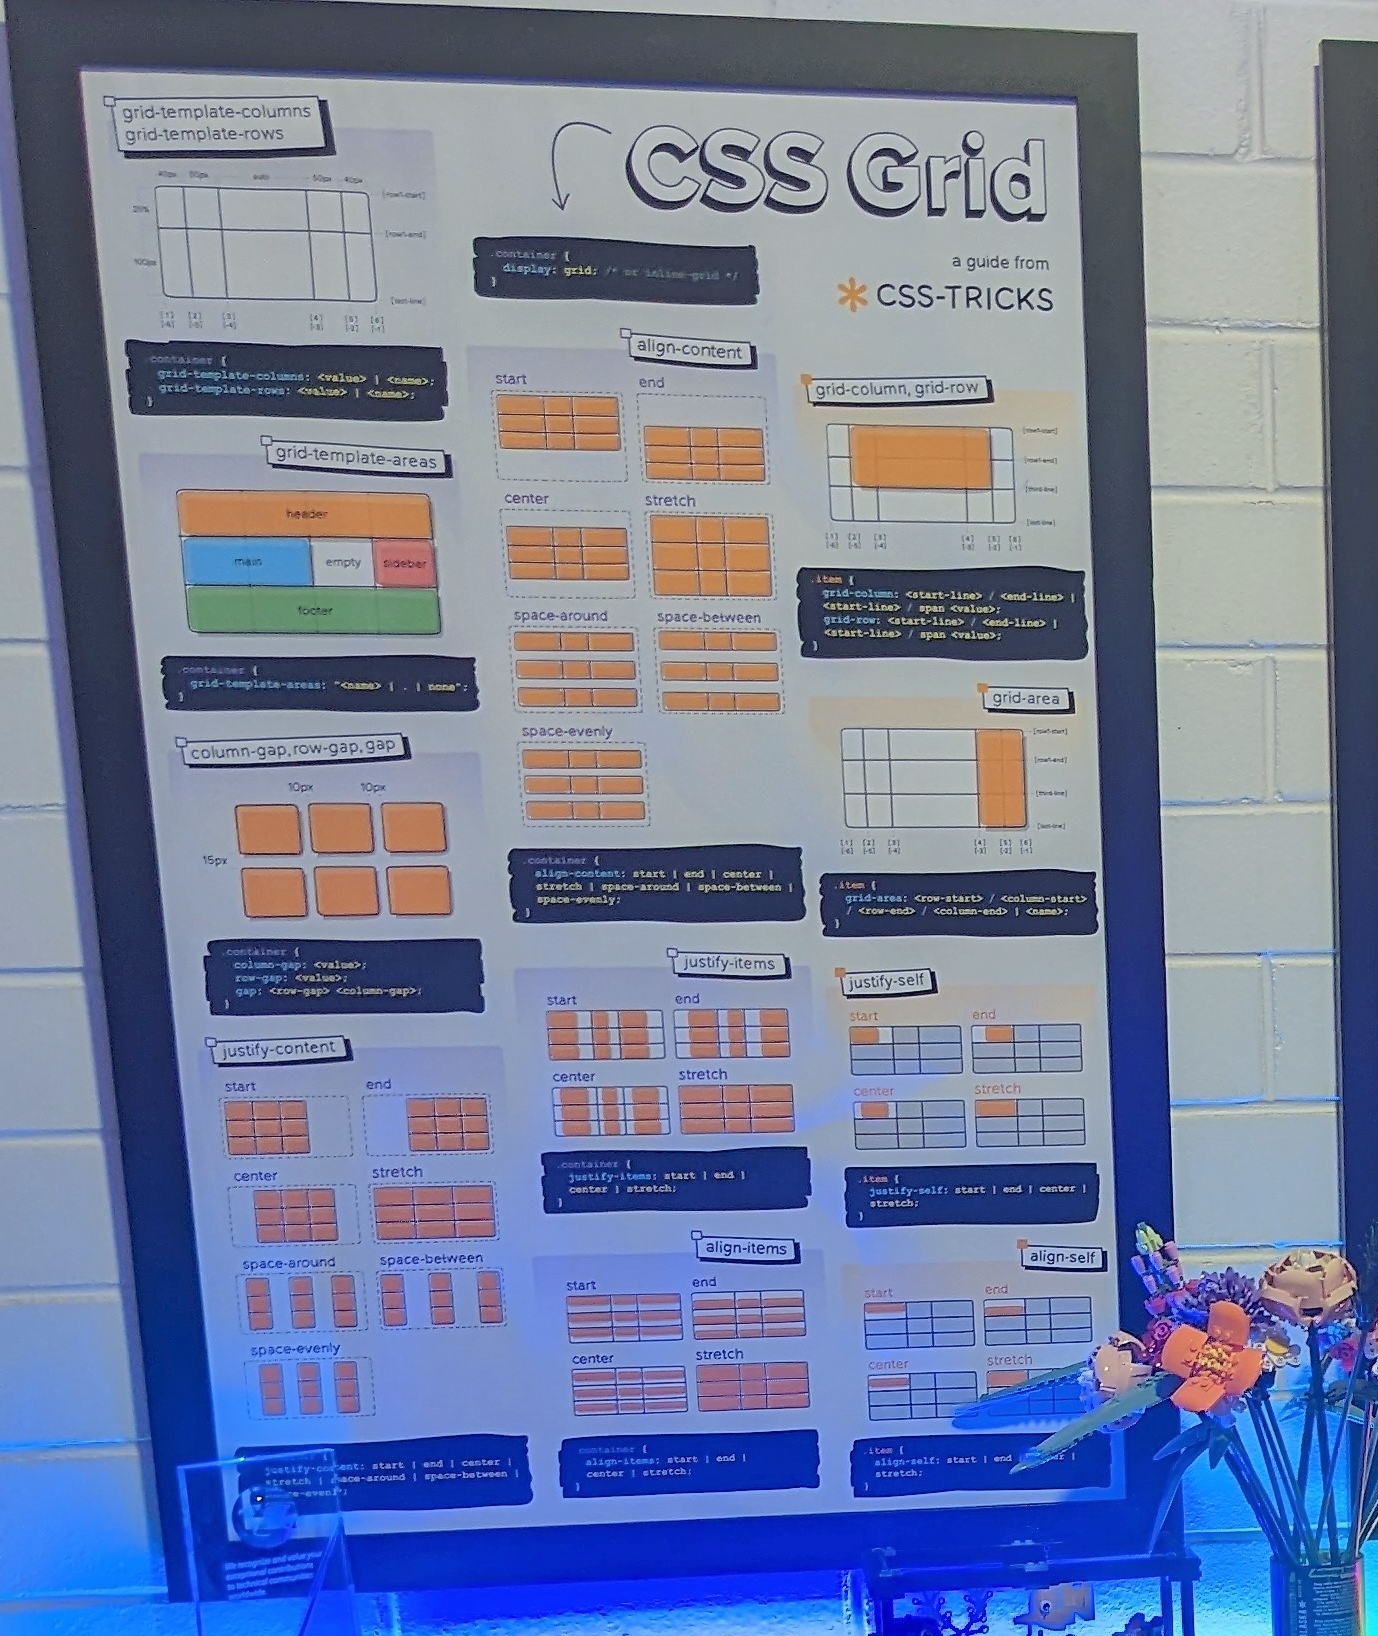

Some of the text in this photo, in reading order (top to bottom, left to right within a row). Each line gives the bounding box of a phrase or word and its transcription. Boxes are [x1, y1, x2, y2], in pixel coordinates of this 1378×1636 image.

[122, 103, 311, 121] grid-template-columns
[125, 124, 284, 143] grid-template-rows
[625, 124, 1049, 222] CSS Grid
[502, 261, 557, 276] display:
[563, 263, 597, 276] grid;
[952, 254, 1050, 275] a guide from
[876, 284, 1054, 312] CSS-TRICKS
[637, 338, 743, 361] align-content
[495, 373, 665, 389] start end
[816, 380, 978, 400] grid-column, grid-row
[276, 446, 437, 469] grid-template-areas
[504, 493, 696, 507] center stretch
[286, 508, 328, 519] header
[234, 557, 427, 570] main empty sidebar
[822, 588, 899, 599] grid-column:
[298, 605, 333, 616] footer
[514, 610, 762, 624] space-around space-between
[993, 691, 1060, 707] grid-area
[522, 726, 614, 739] space-evenly
[191, 739, 396, 760] column-gap, row-gap, gap
[288, 781, 387, 794] 10px 10px
[203, 855, 228, 867] 15px
[683, 955, 776, 971] justify-items
[849, 973, 924, 992] justify-self
[547, 993, 700, 1006] start end
[849, 1009, 996, 1022] start end
[221, 1040, 336, 1060] justify-content
[552, 1068, 728, 1083] center stretch
[225, 1079, 392, 1092] start end
[853, 1082, 1021, 1097] center stretch
[234, 1166, 424, 1182] center stretch
[705, 1239, 788, 1256] align-items
[242, 1253, 484, 1271] space-around space-between
[1030, 1251, 1096, 1266] align-self
[566, 1277, 717, 1291] start end
[864, 1284, 1008, 1298] start end
[251, 1343, 341, 1357] space-evenly
[572, 1349, 744, 1365] center stretch
[868, 1354, 1033, 1370] center stretch
